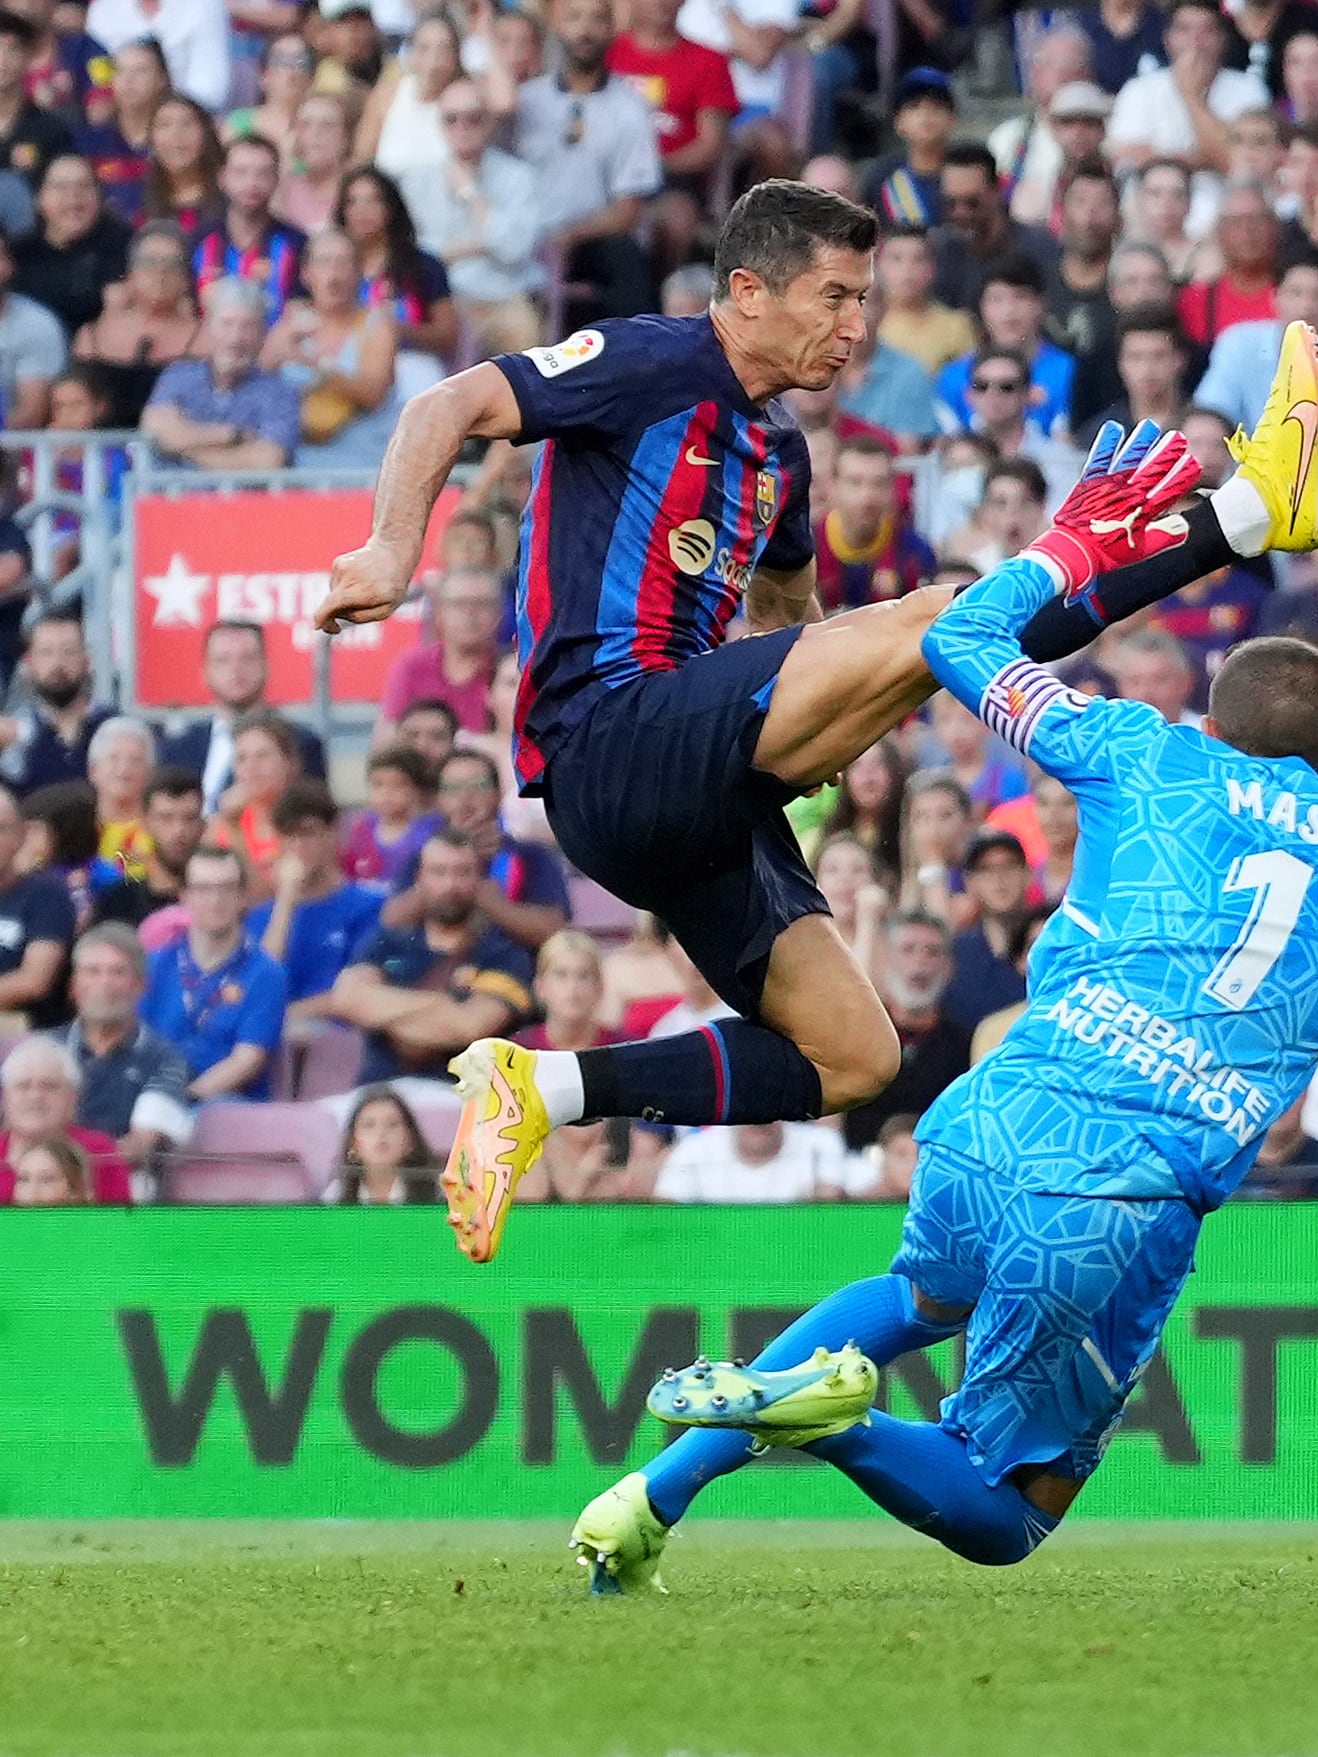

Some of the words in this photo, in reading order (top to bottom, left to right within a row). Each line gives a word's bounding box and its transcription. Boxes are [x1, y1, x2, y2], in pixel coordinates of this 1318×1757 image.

[1200, 849, 1315, 1011] 1
[1045, 998, 1258, 1148] NUTRITION
[1067, 975, 1272, 1123] HERBALIFE
[115, 1303, 969, 1469] WOM
